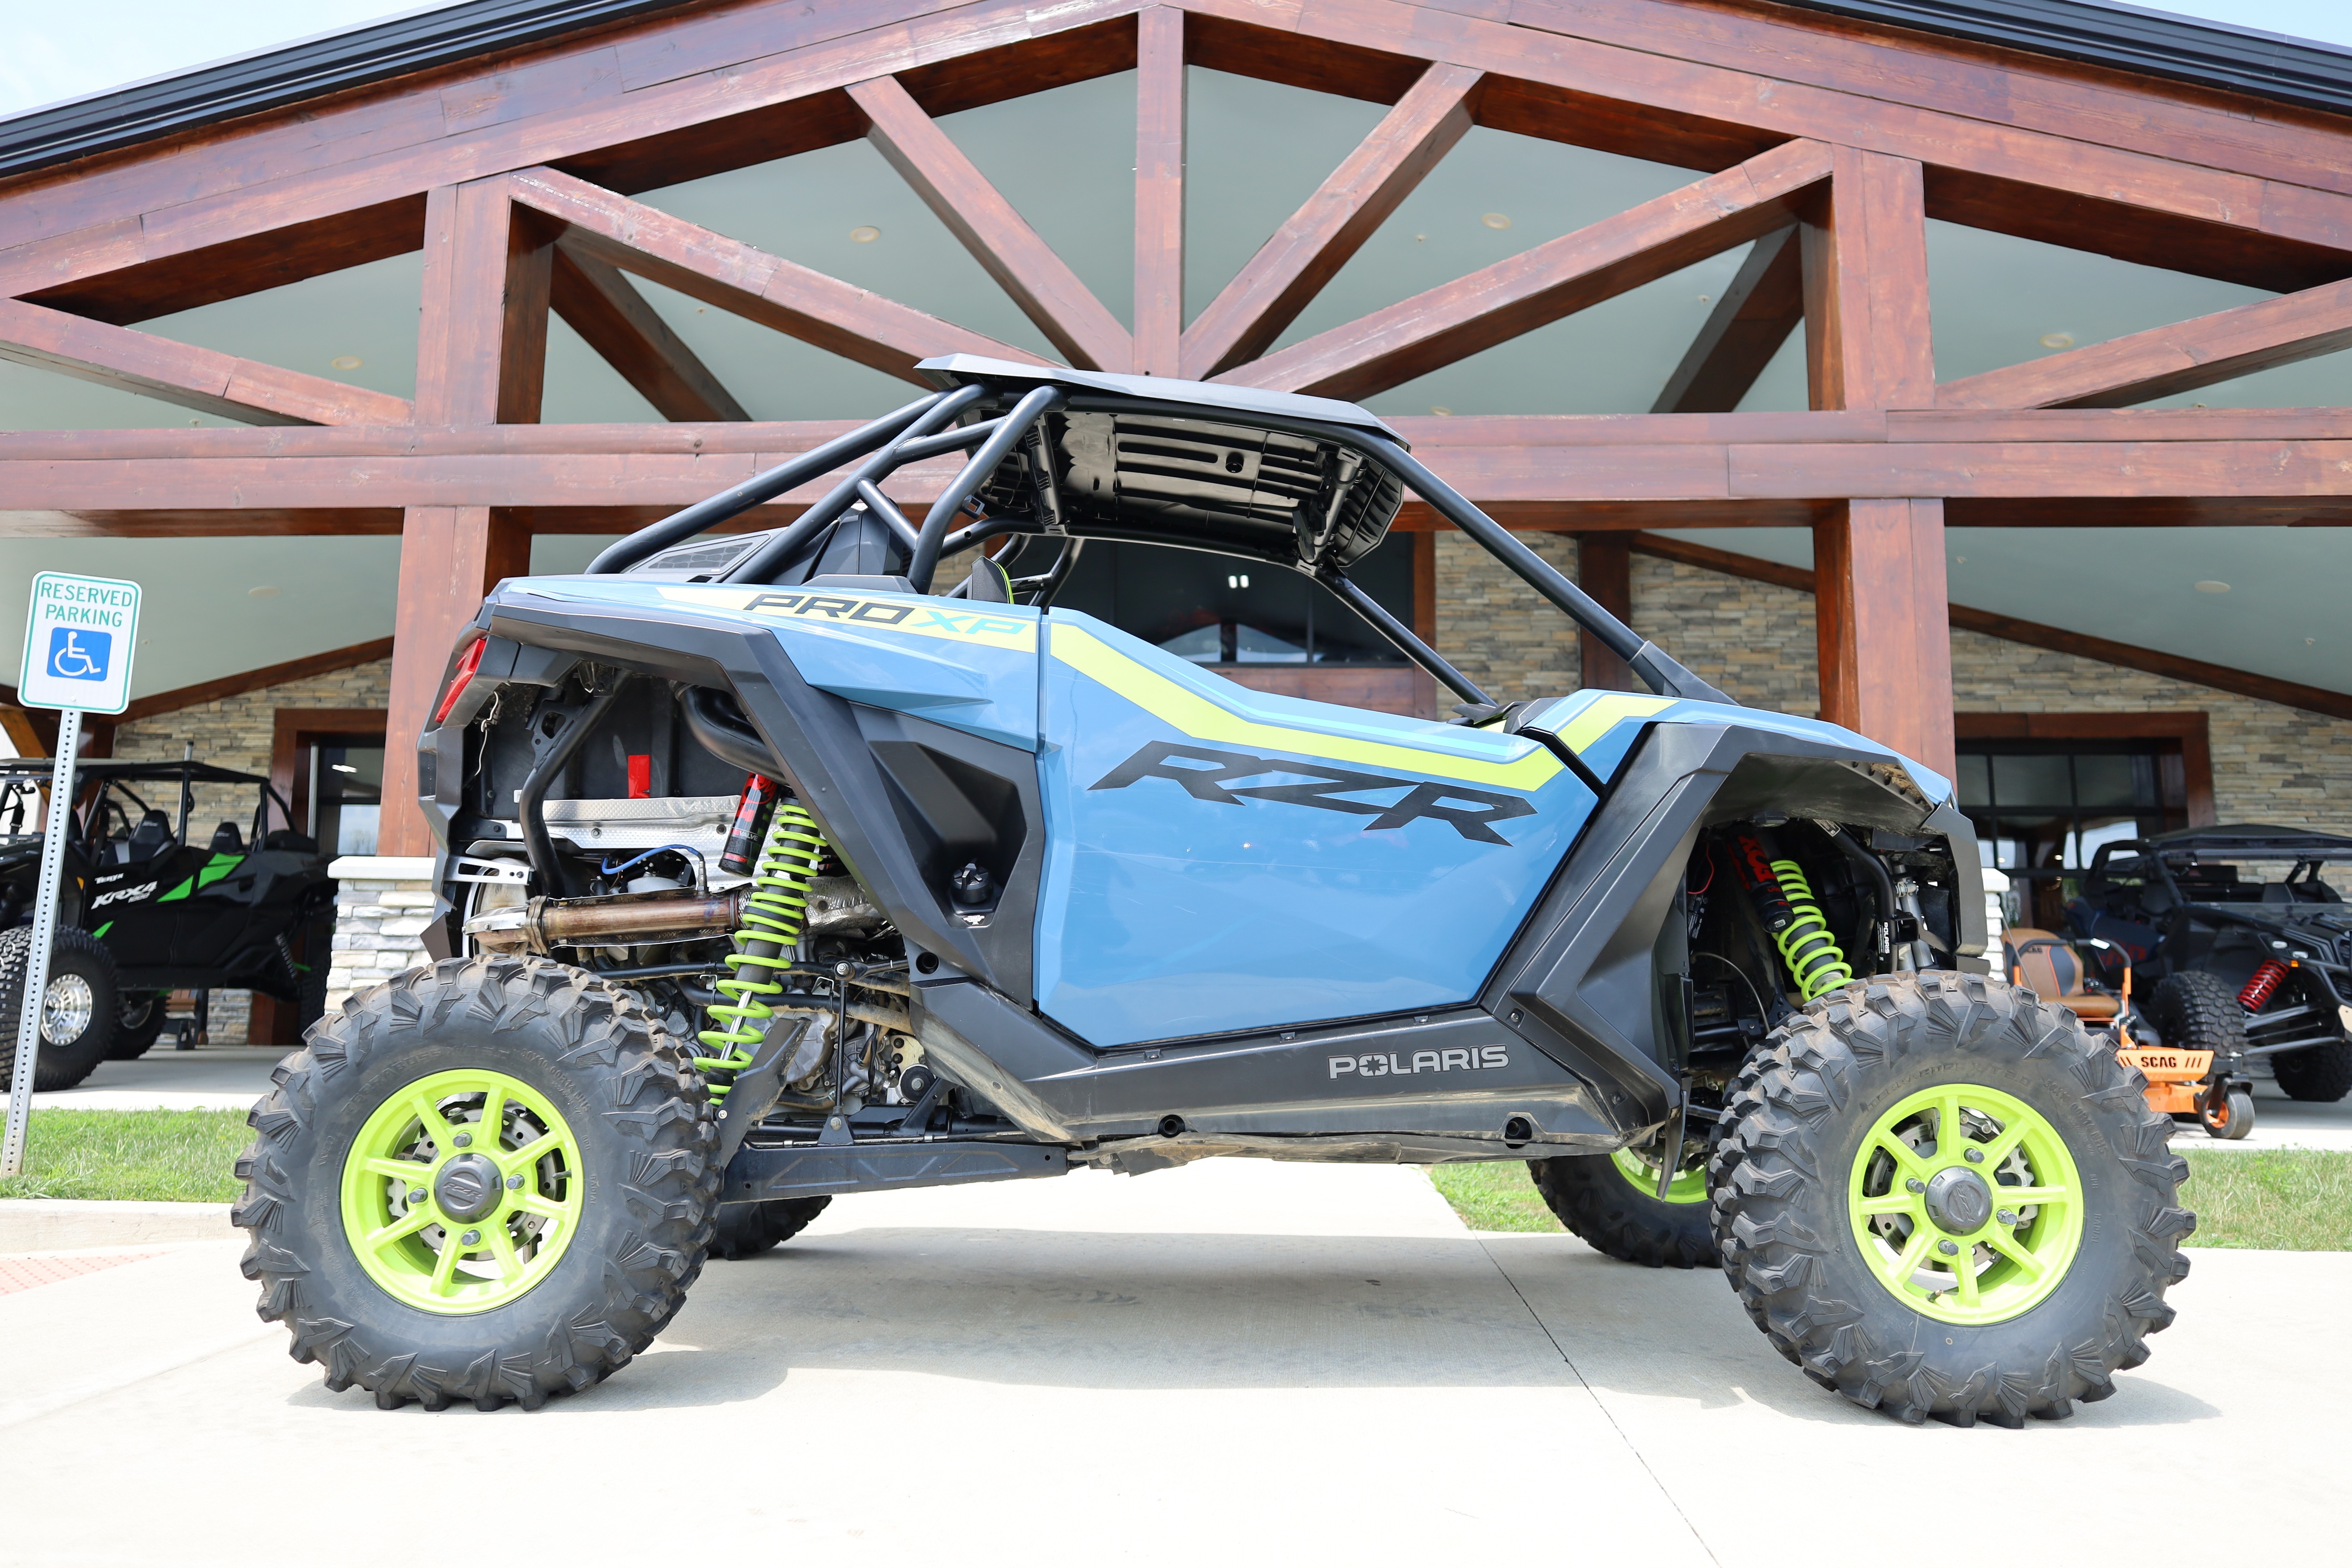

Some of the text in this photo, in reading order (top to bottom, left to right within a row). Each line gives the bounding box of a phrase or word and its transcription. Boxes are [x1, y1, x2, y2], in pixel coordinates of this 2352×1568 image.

[40, 582, 132, 607] RESERVED
[45, 603, 122, 627] PARKING
[743, 594, 1028, 634] PRO XP
[1086, 740, 1539, 847] RZR
[1329, 1044, 1509, 1079] POLARIS
[2141, 1057, 2177, 1067] SCAG
[589, 1173, 598, 1207] RADIAL
[2088, 1212, 2104, 1246] RADIAL
